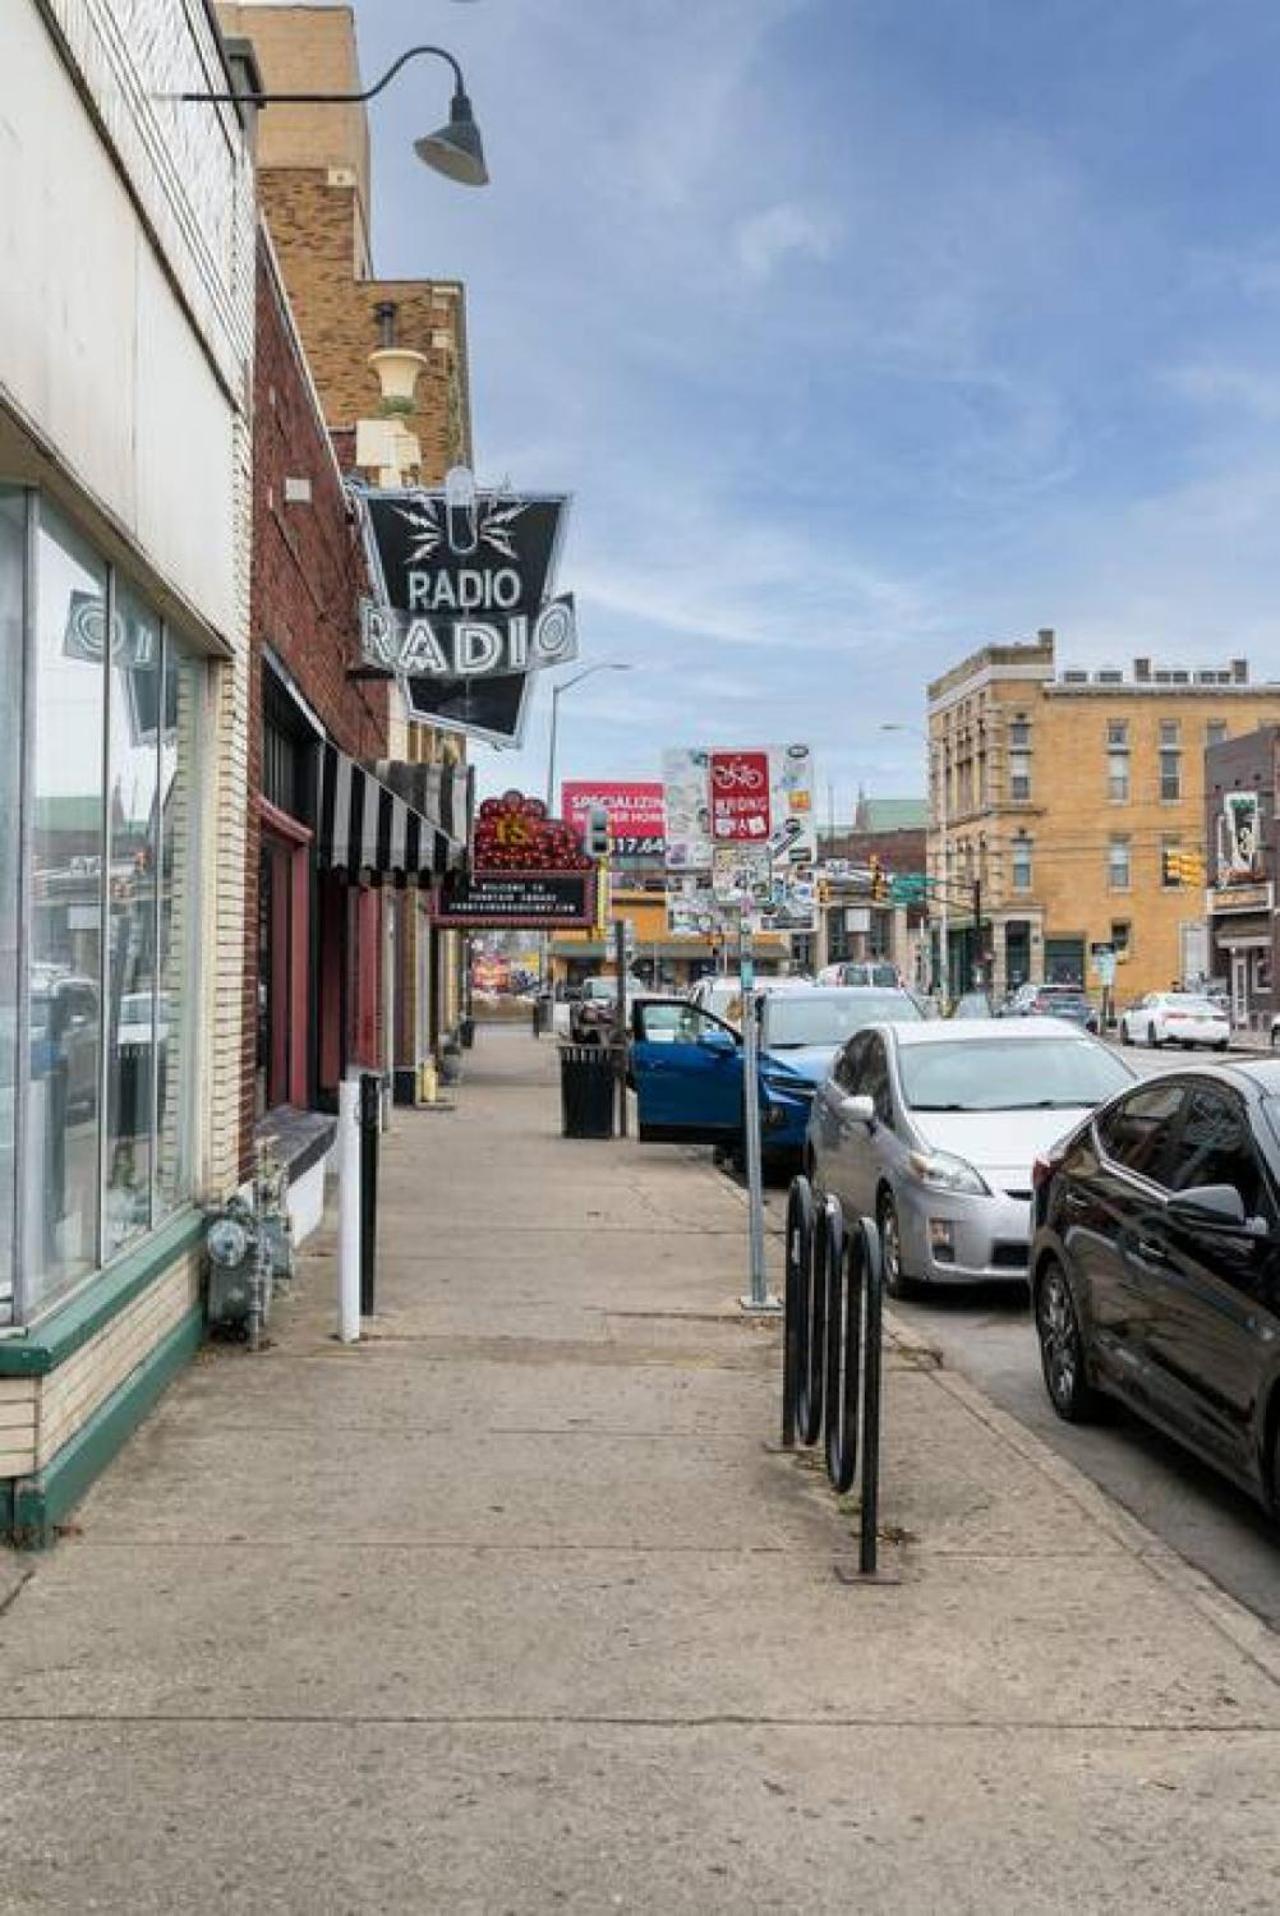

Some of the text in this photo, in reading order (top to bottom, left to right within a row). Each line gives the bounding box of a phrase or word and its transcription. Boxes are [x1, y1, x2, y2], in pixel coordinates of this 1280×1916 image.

[408, 569, 521, 610] RADIO
[361, 602, 572, 675] RADIO
[572, 795, 664, 809] SPECIALIZIN
